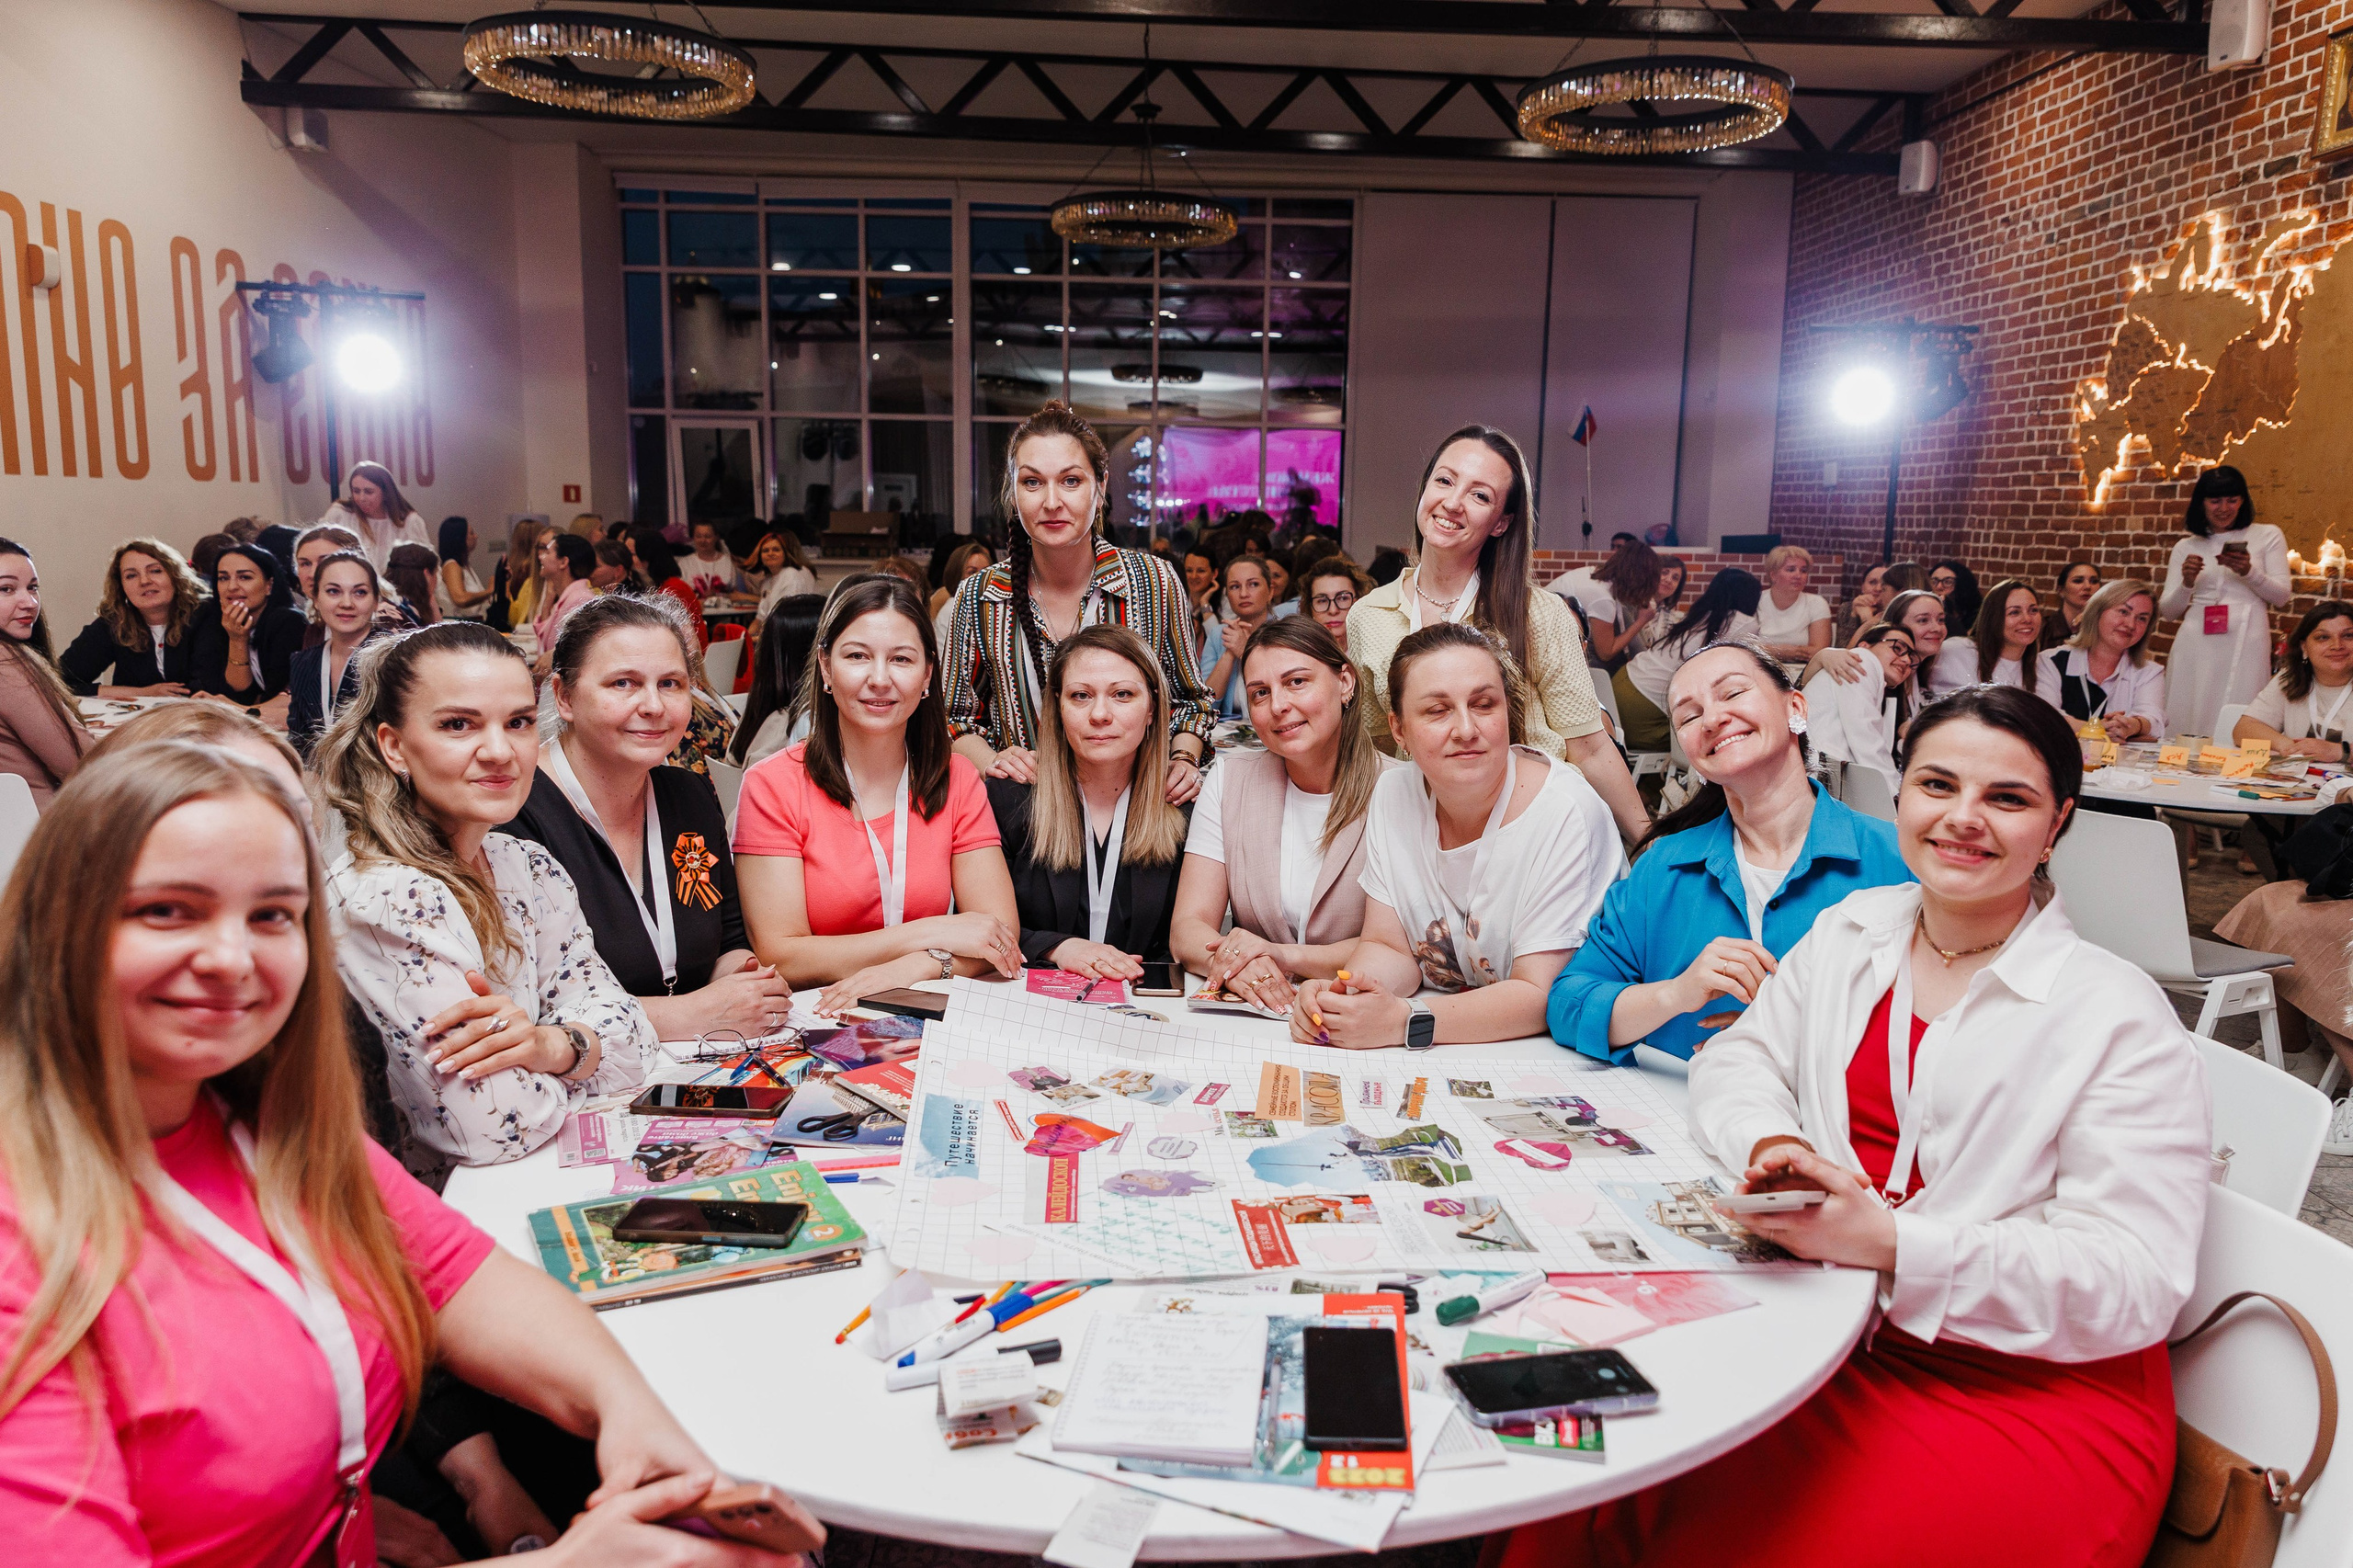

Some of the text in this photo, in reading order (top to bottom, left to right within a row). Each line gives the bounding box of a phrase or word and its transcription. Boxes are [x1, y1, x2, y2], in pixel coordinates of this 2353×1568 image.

[1309, 1071, 1340, 1125] КРАСОТА
[945, 1103, 964, 1167] Путешествие
[965, 1108, 980, 1165] начинается
[1050, 1157, 1069, 1223] КАЛЕЙДОСКОП
[813, 1227, 835, 1237] 2
